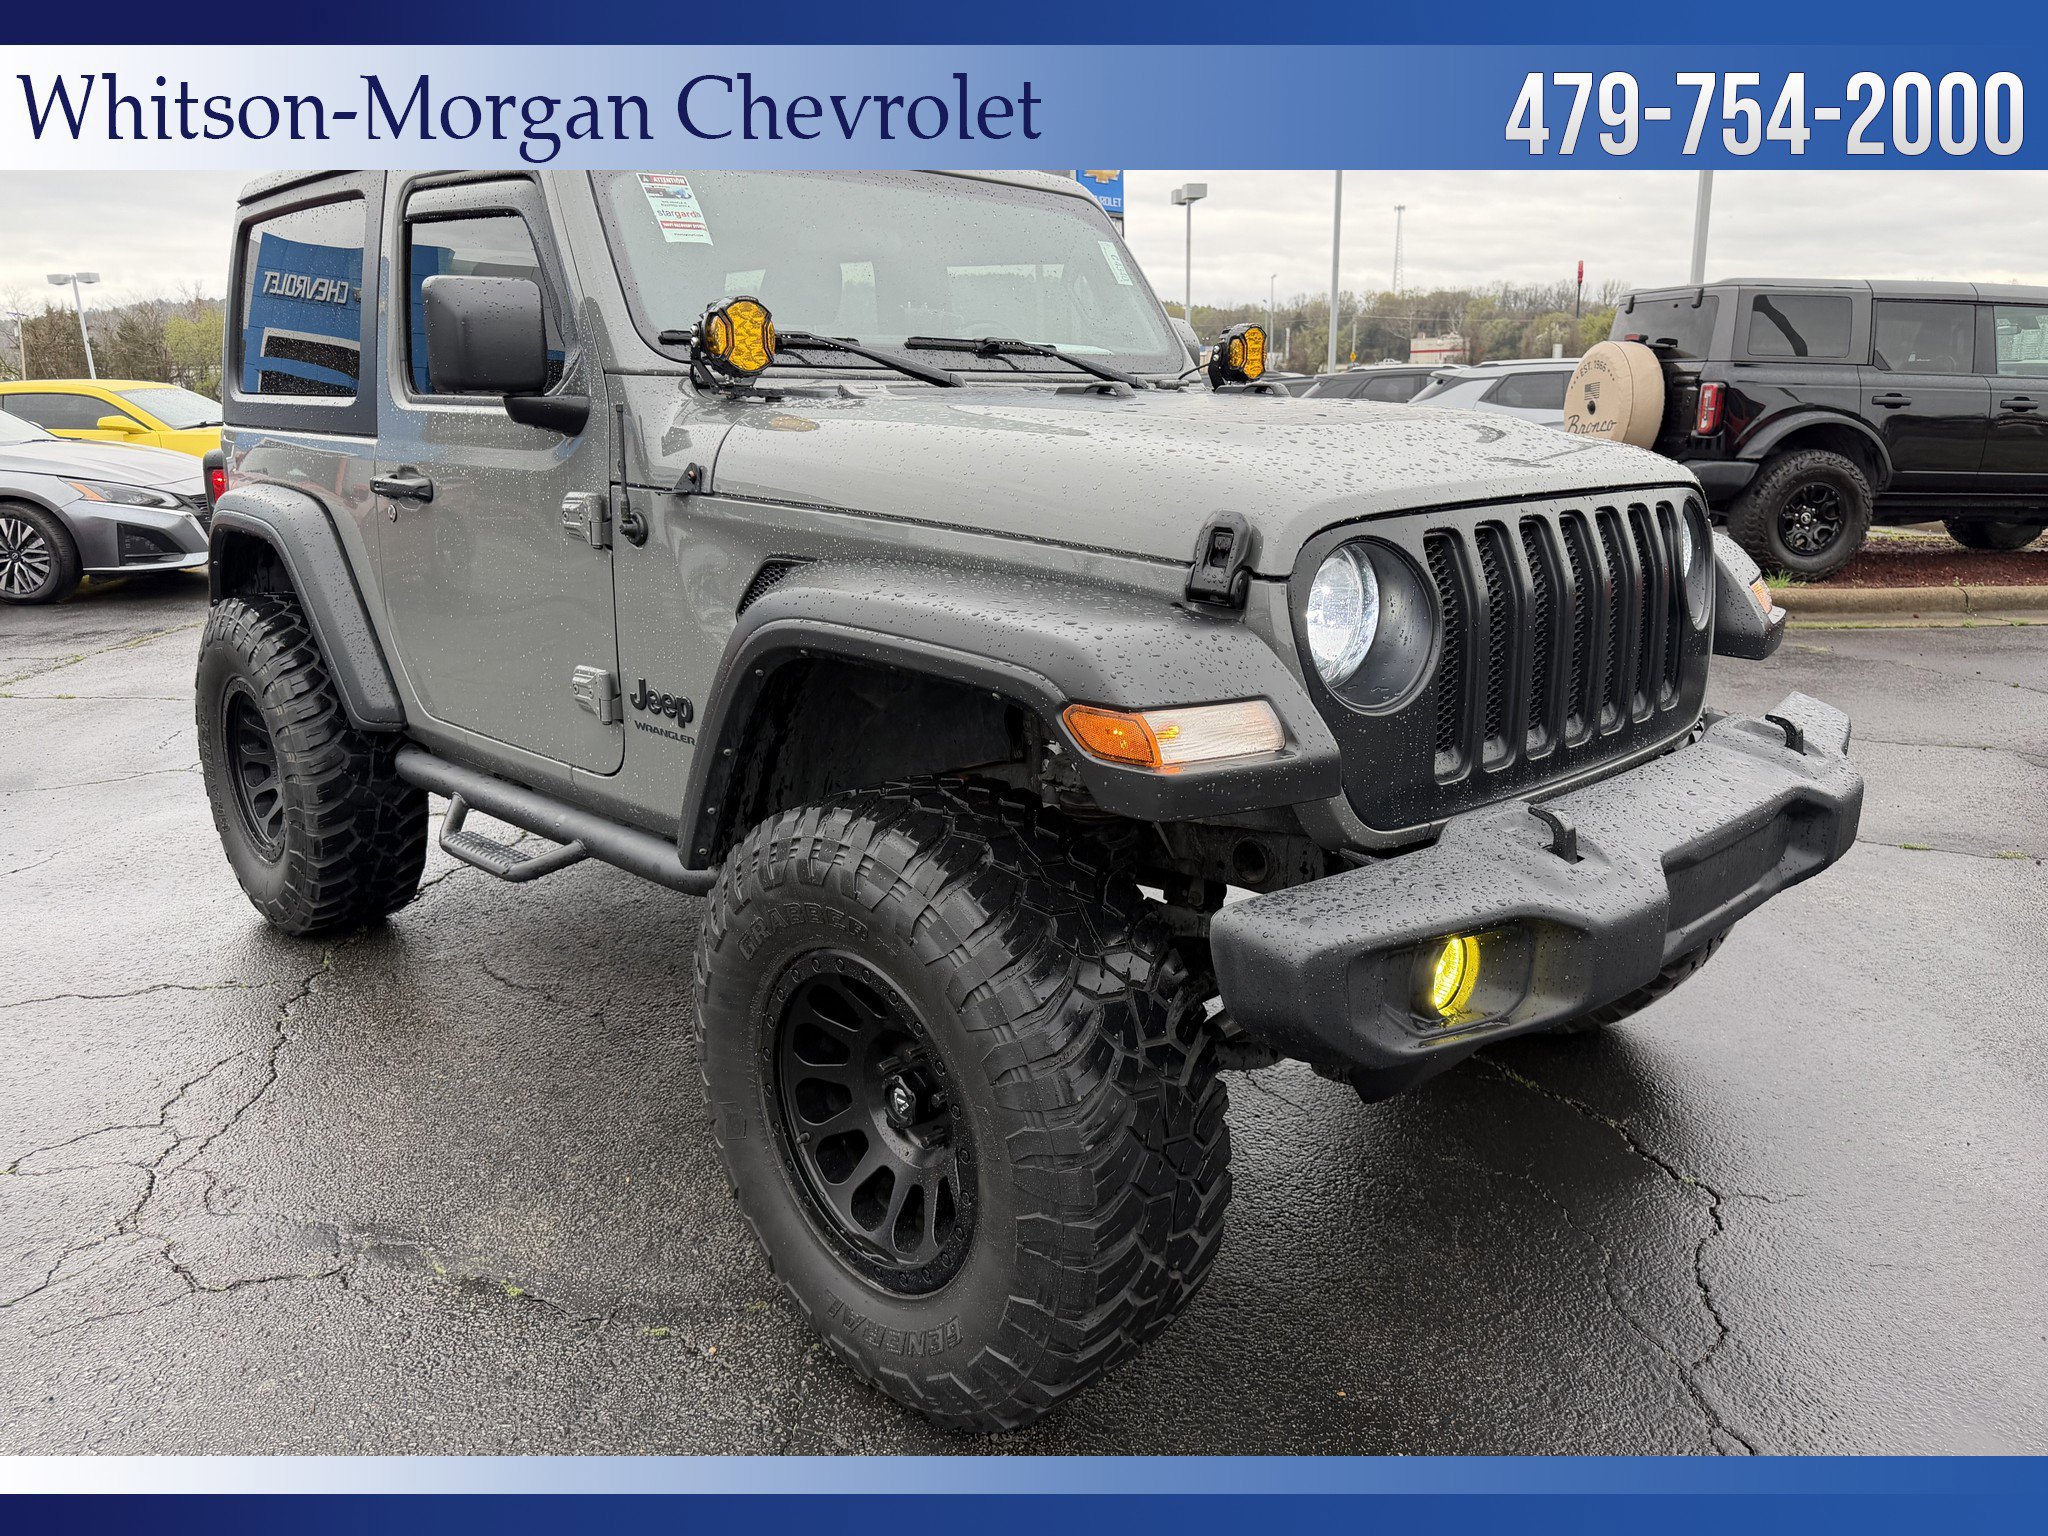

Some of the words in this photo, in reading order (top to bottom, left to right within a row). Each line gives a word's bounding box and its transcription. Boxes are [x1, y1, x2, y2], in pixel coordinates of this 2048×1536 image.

[653, 176, 686, 185] ATTENTION
[1097, 195, 1122, 207] ROLET
[1580, 361, 1592, 377] EST.
[1567, 414, 1617, 434] Bronco
[630, 677, 694, 729] Jeep
[634, 720, 696, 746] WRANGLER
[737, 902, 869, 961] GRABBER
[824, 1288, 963, 1358] GENERAL
